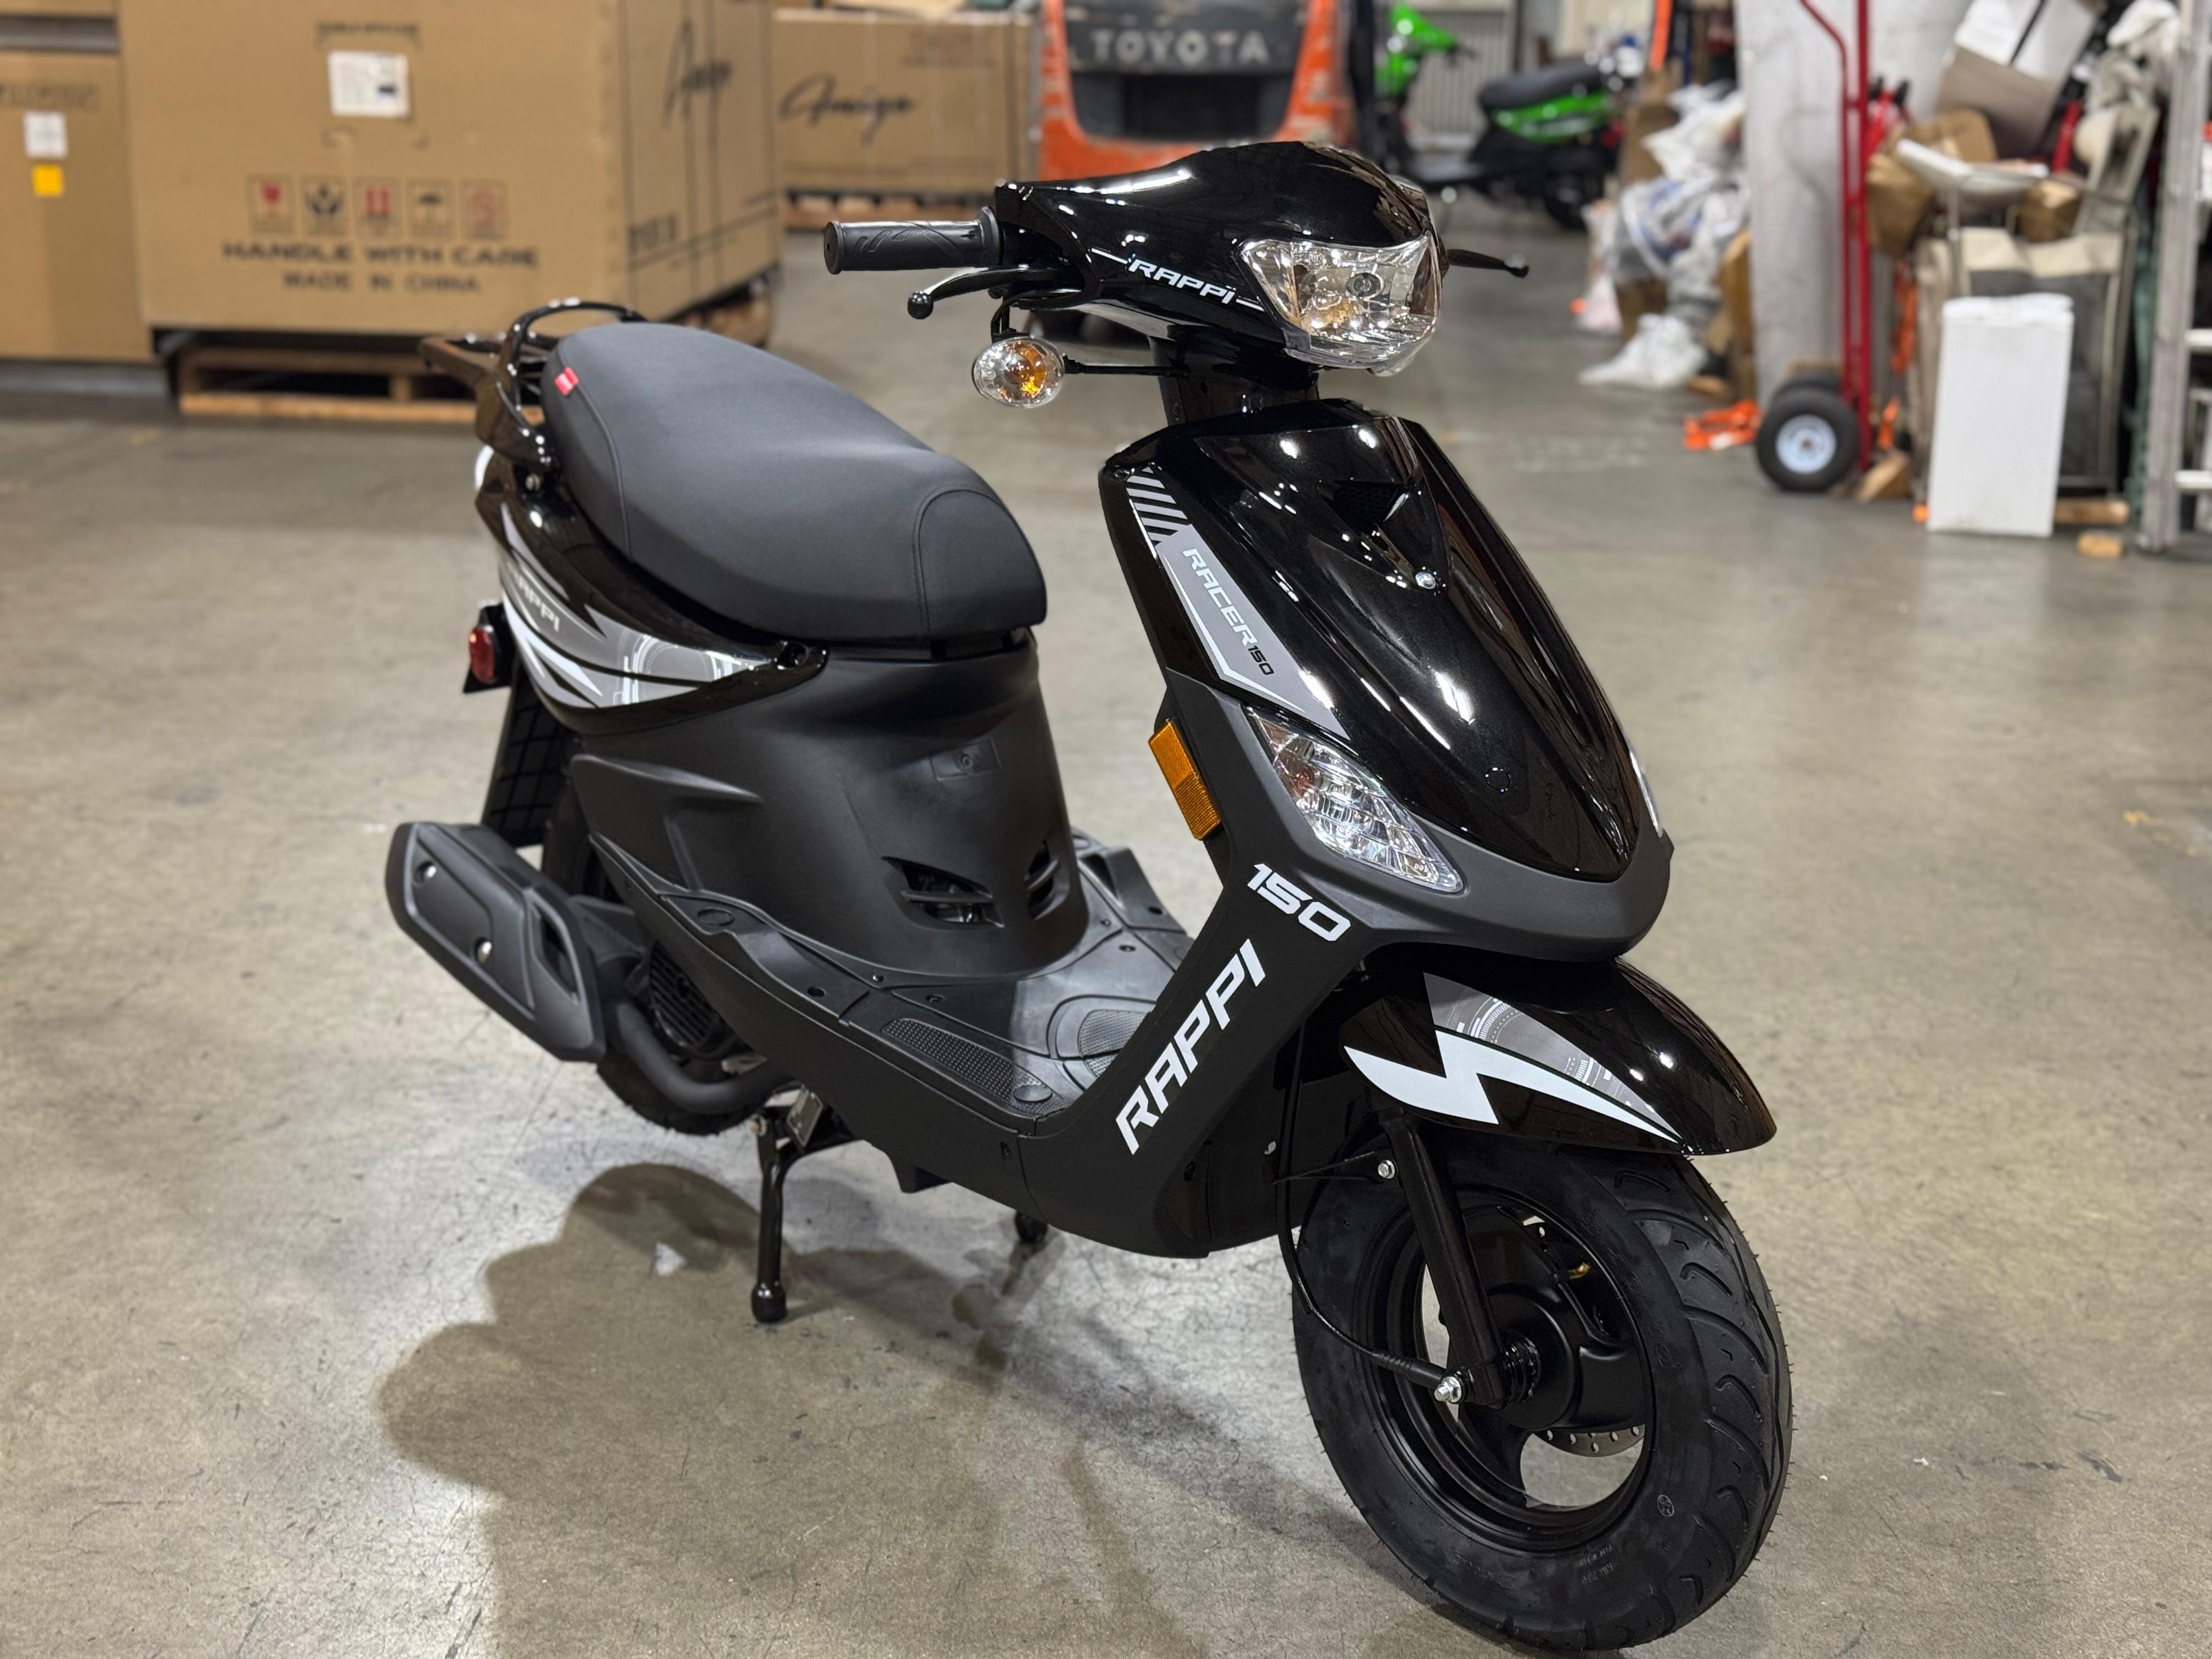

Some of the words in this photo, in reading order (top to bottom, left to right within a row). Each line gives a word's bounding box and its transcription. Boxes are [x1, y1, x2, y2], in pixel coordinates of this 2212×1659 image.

[1091, 30, 1270, 65] TOYOTA
[222, 242, 351, 263] HANDLE
[365, 246, 443, 264] WITH
[452, 247, 538, 268] CARE
[283, 274, 350, 290] MADE
[407, 276, 478, 292] CHINA
[1128, 259, 1235, 304] RAPPI
[1182, 548, 1258, 647] RACER
[1247, 645, 1275, 676] 150
[1247, 863, 1351, 941] 150
[1116, 939, 1266, 1155] RAPPI
